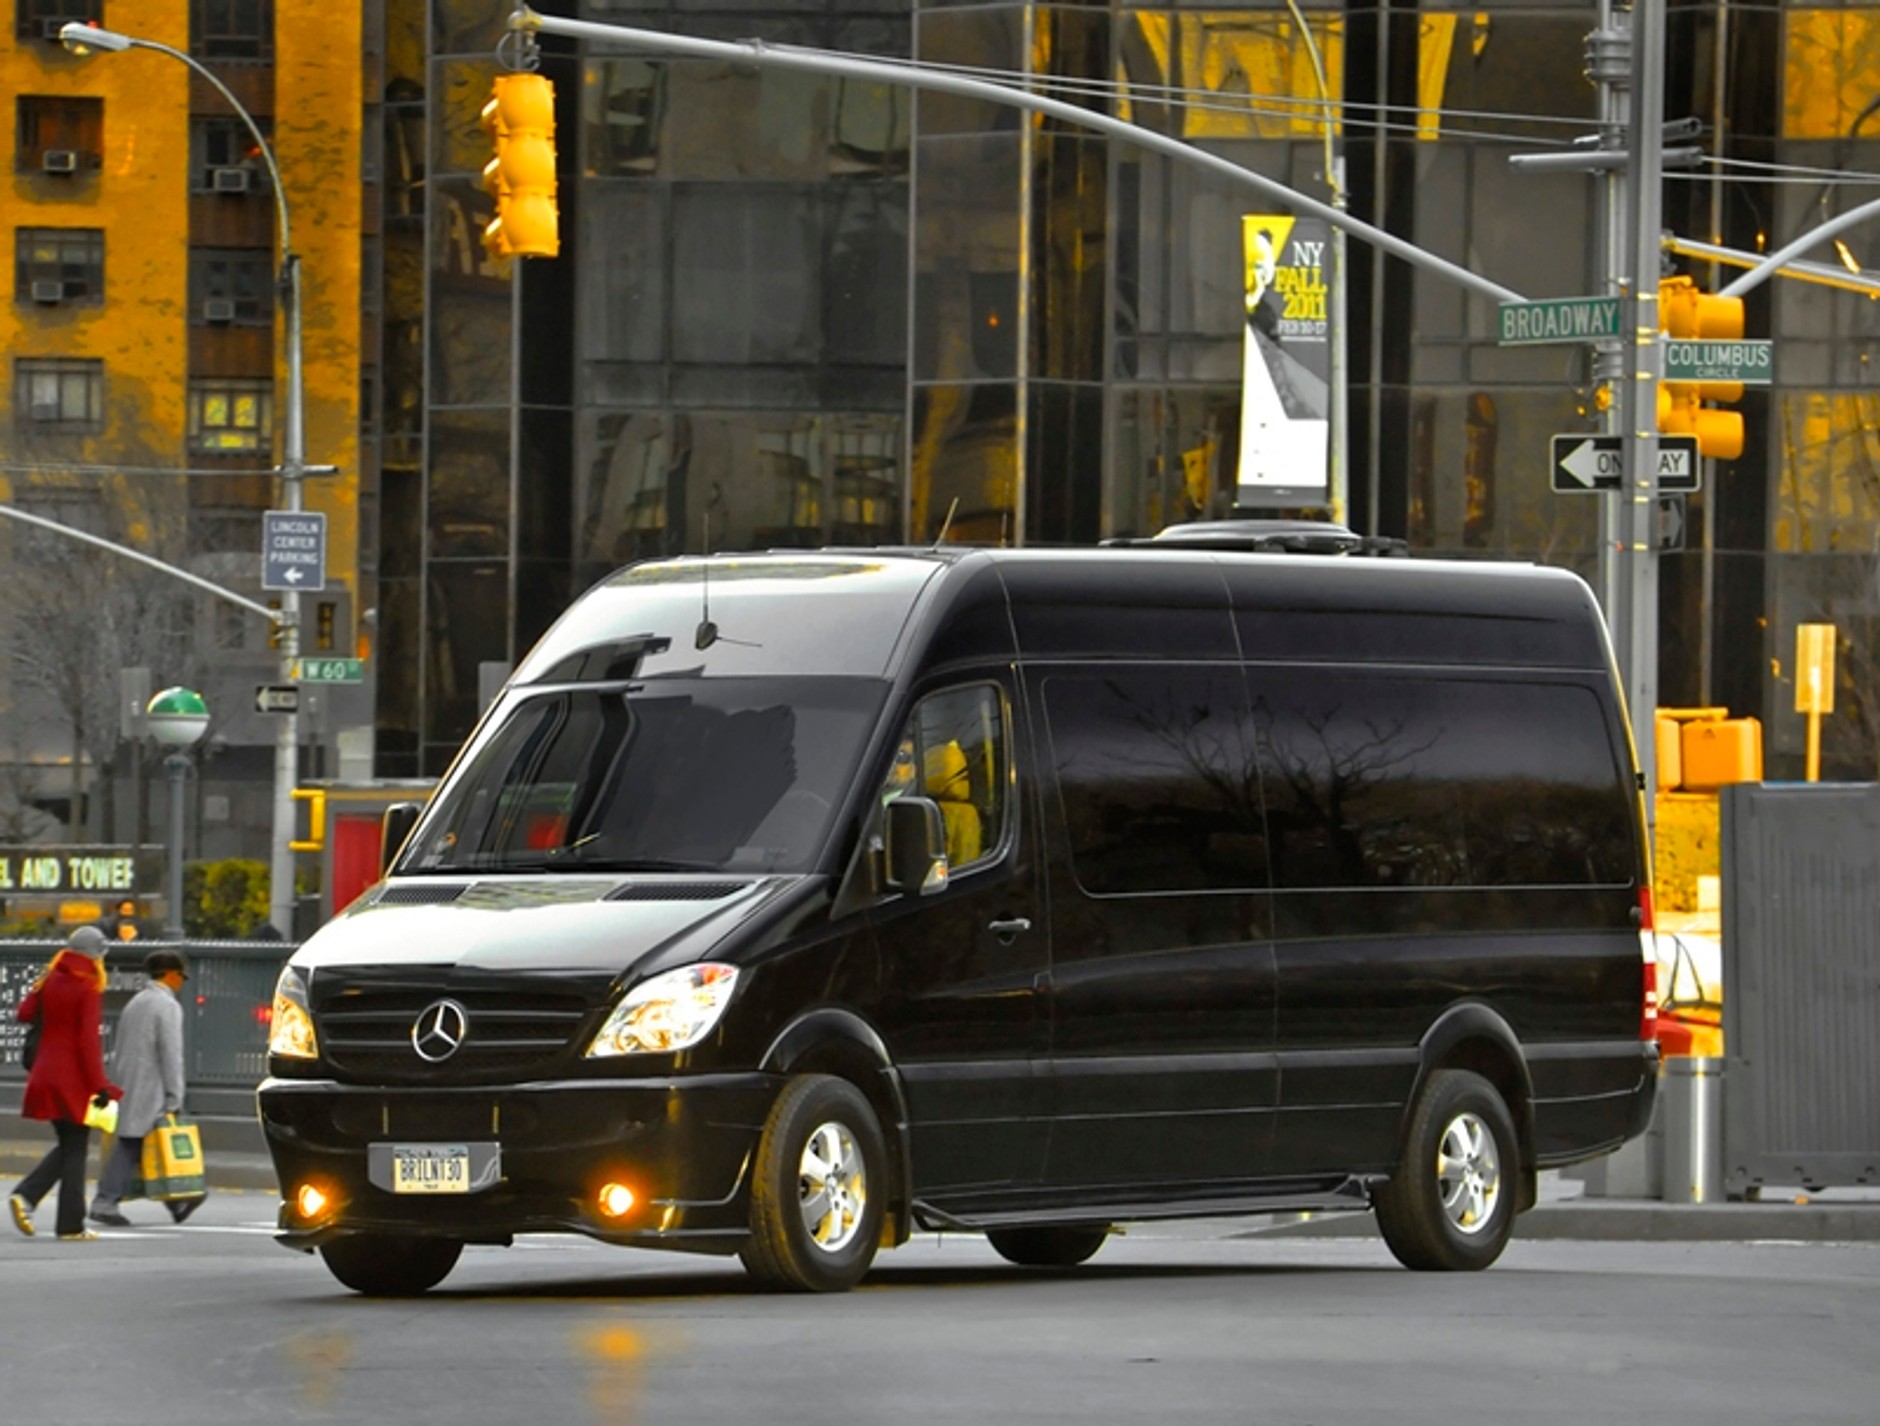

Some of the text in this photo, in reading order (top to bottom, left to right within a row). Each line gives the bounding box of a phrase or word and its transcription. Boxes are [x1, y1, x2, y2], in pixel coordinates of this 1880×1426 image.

[1292, 241, 1325, 267] NY
[1274, 266, 1328, 293] FALL
[1283, 293, 1327, 320] 2011
[1503, 303, 1616, 339] BROADWAY
[1668, 344, 1770, 368] COLUMBUS
[1696, 367, 1739, 379] CIRCLE
[1597, 453, 1684, 473] ON AY
[270, 521, 318, 534] LINCOLN
[273, 535, 316, 549] CENTER
[270, 551, 318, 565] PARKING
[306, 662, 320, 678] W
[322, 662, 346, 679] 60
[20, 857, 60, 889] AND
